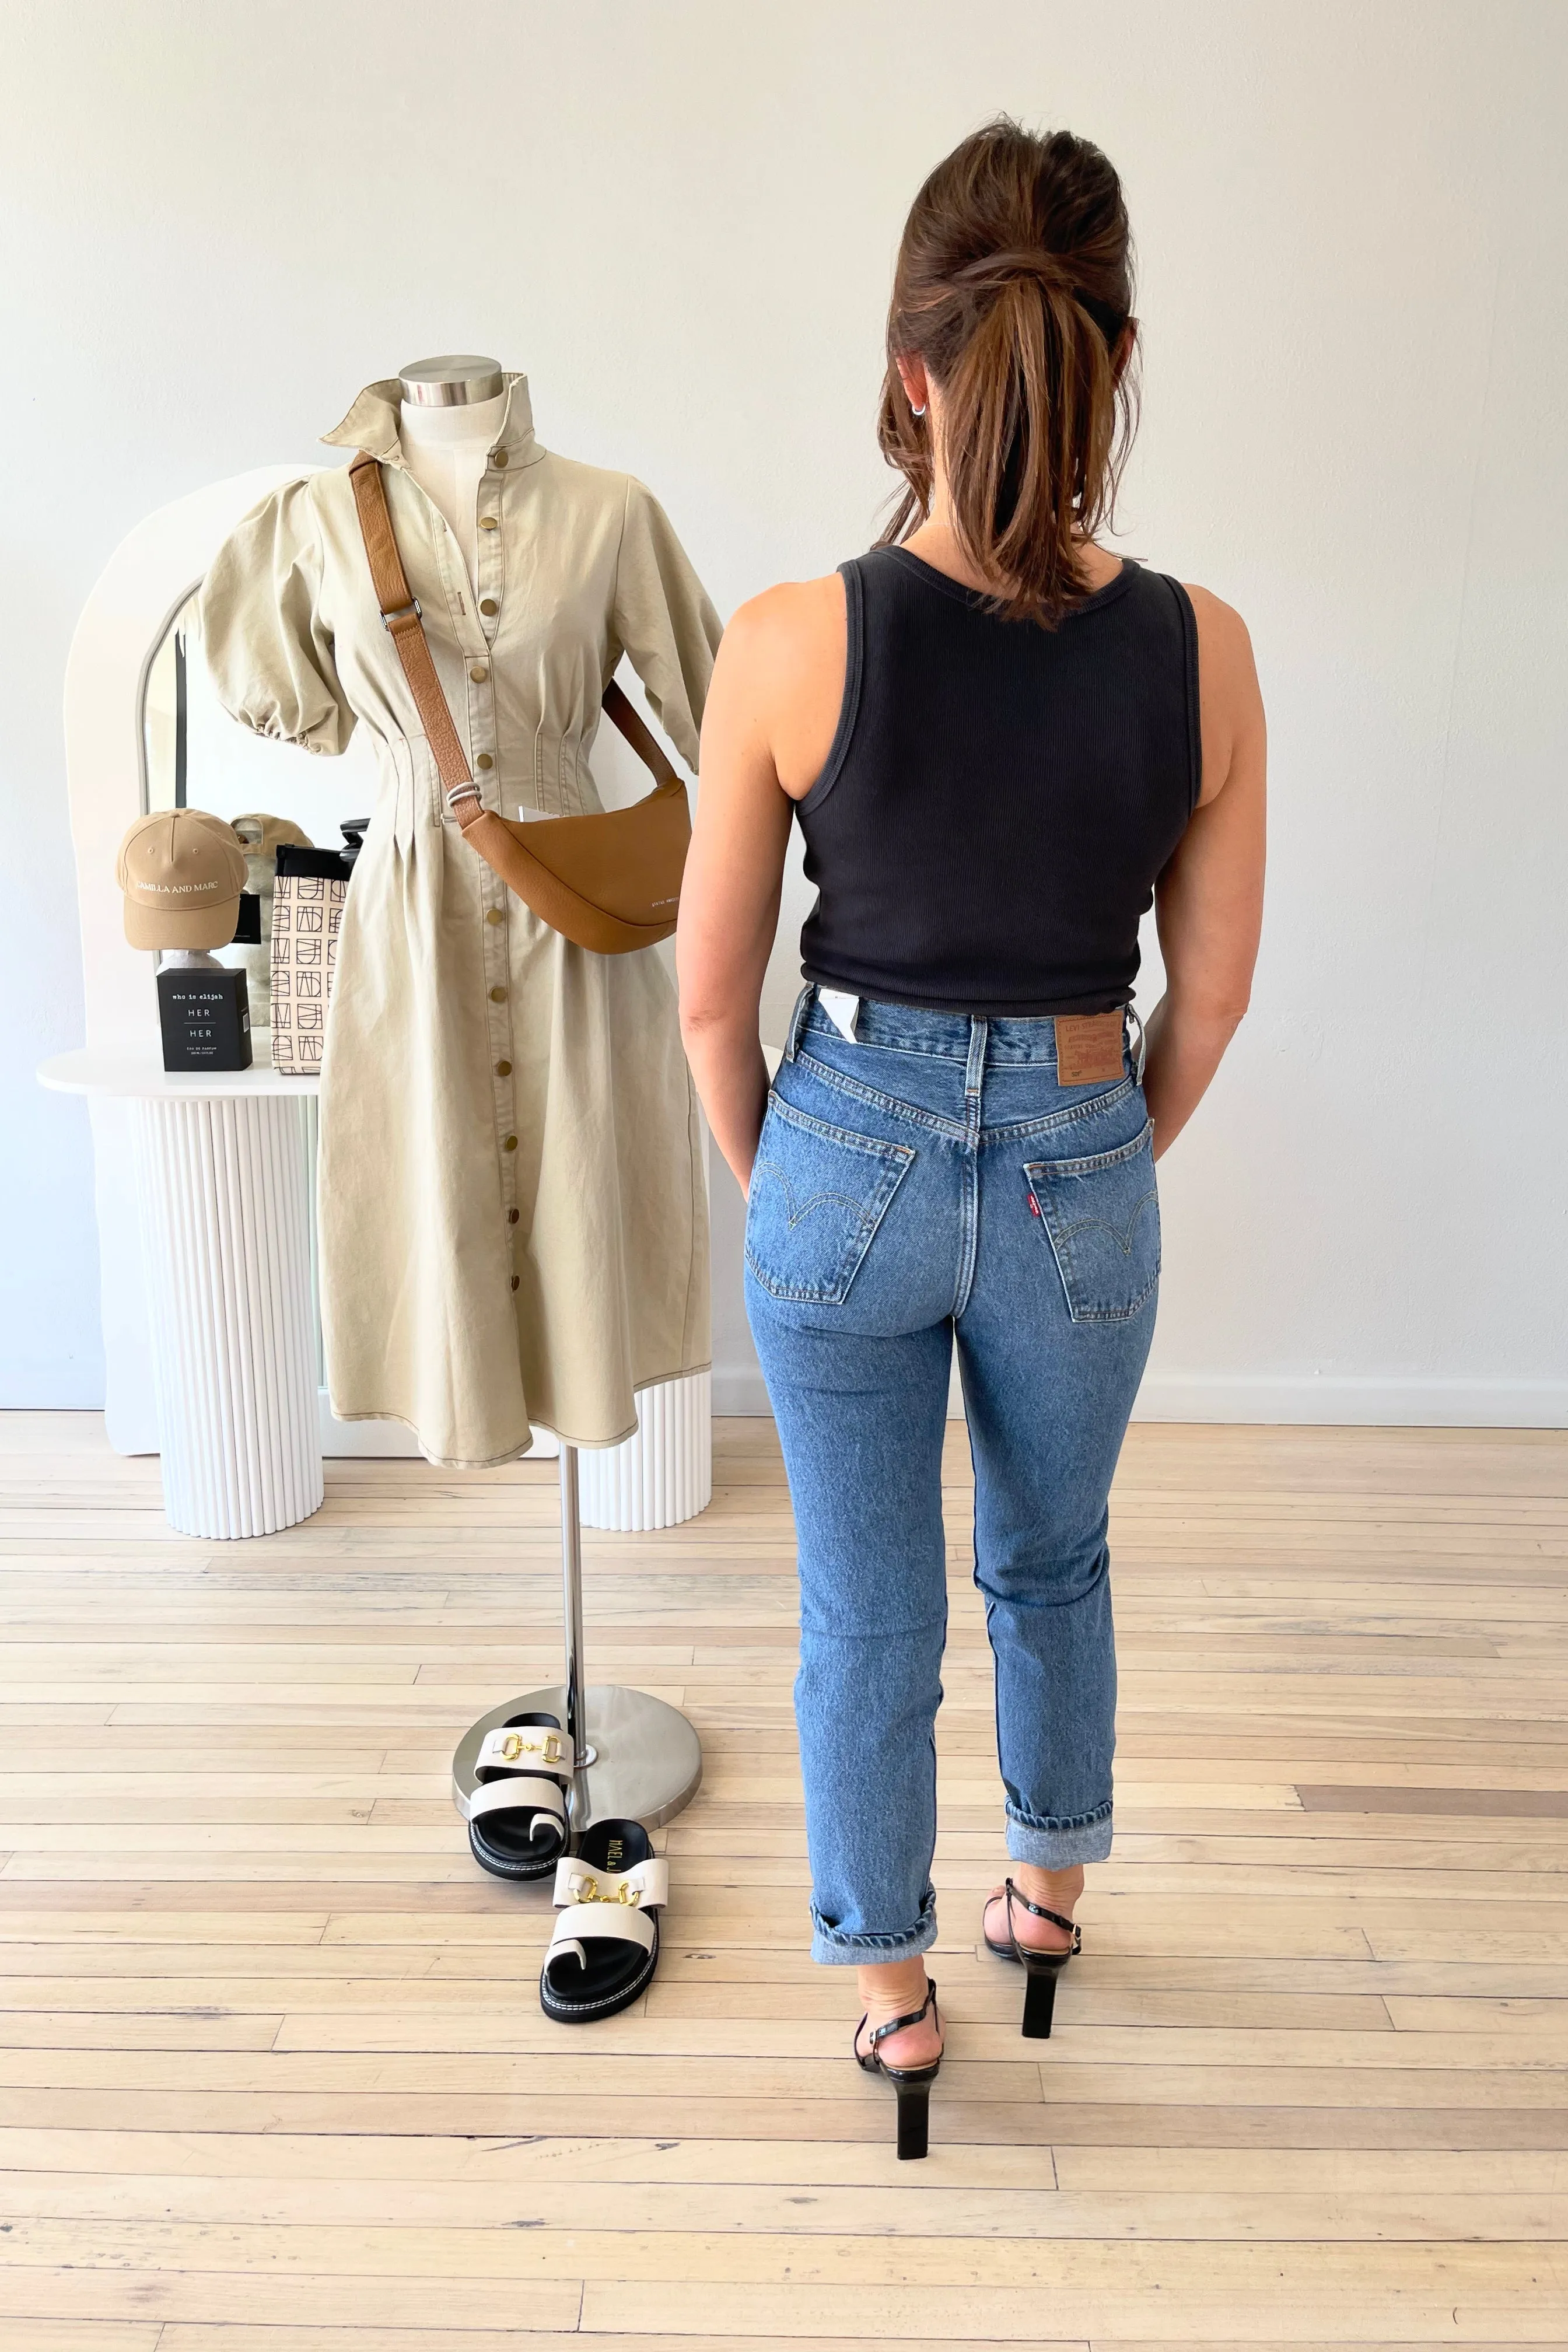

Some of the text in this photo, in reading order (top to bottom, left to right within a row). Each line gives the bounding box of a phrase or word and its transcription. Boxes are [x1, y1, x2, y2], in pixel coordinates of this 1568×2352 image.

[135, 881, 218, 894] CAMILLA AND MARC
[607, 1840, 623, 1860] HAEL
